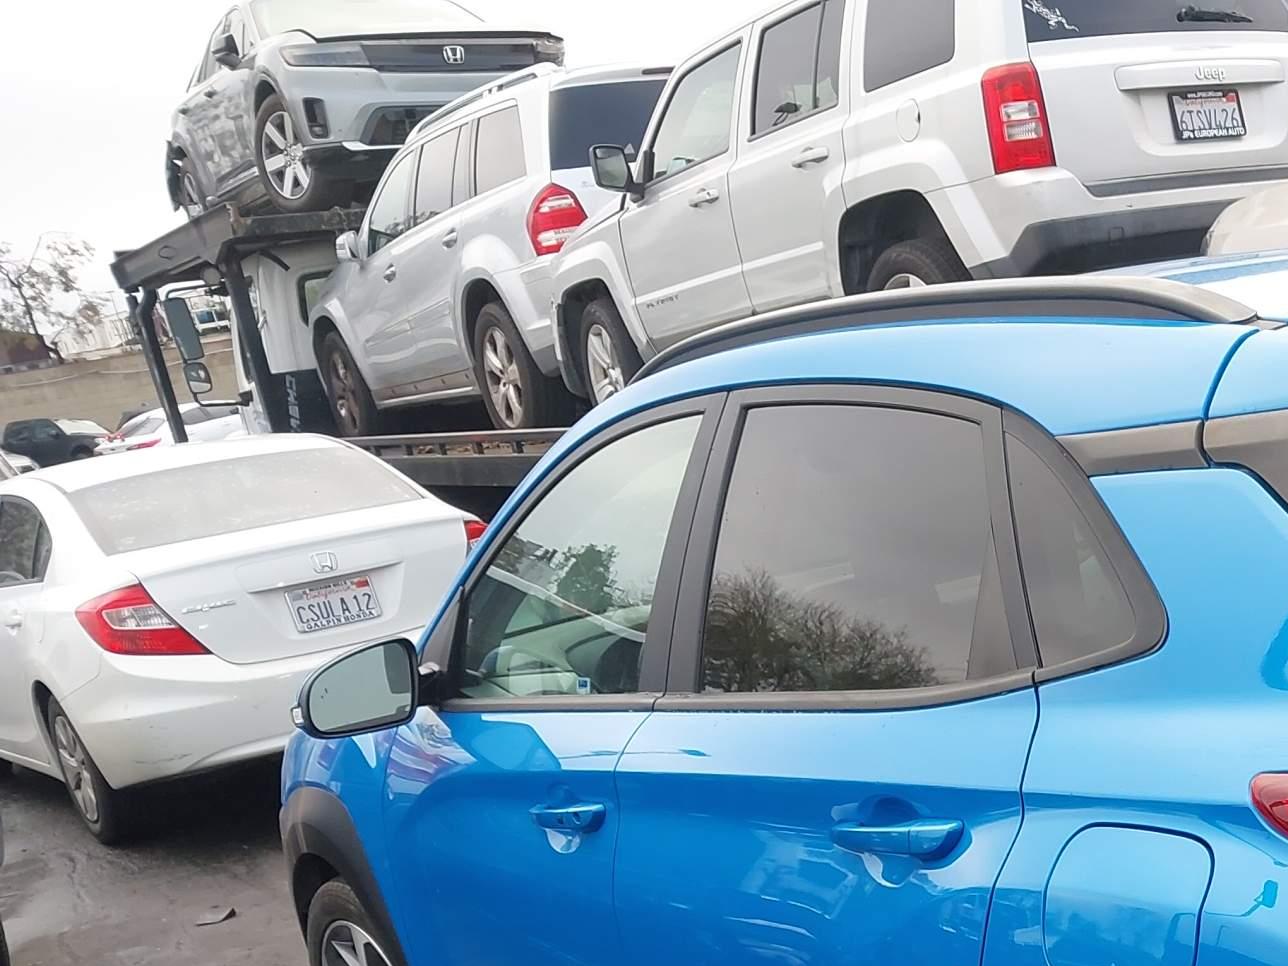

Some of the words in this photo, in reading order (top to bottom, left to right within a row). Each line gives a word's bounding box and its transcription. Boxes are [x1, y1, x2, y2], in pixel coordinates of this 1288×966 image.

[1194, 65, 1226, 82] Jeep
[1179, 107, 1240, 131] 6TSV426
[1194, 128, 1227, 138] EUROPEAN
[1228, 127, 1245, 136] AUTO
[306, 617, 342, 630] GALPIN
[344, 610, 375, 623] HONDA
